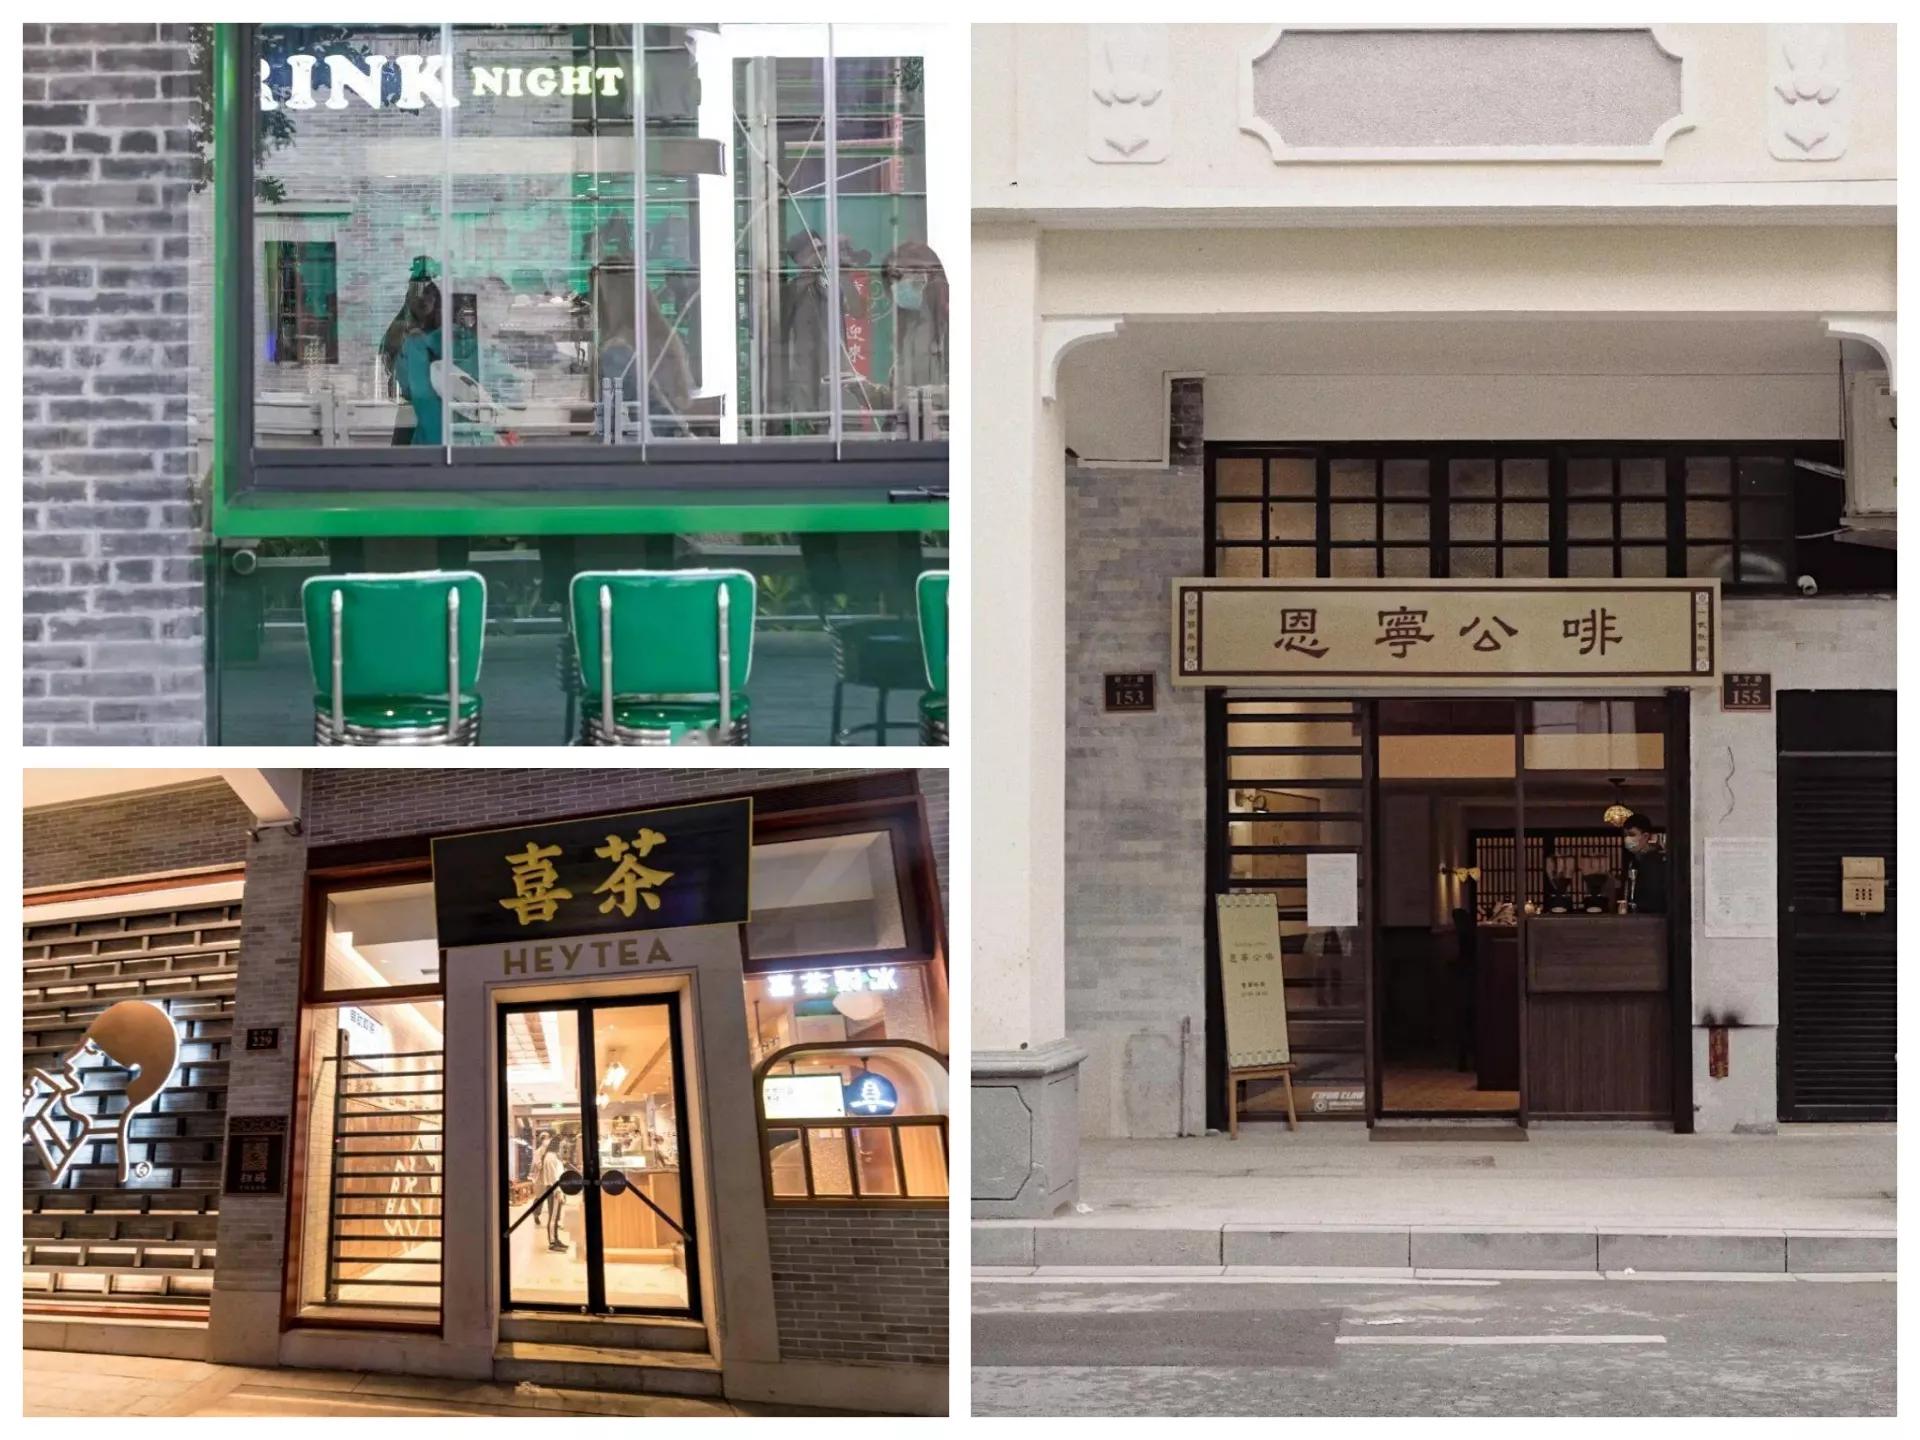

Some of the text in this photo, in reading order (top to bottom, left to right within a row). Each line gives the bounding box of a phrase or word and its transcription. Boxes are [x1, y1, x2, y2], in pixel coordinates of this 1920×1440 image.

[472, 66, 624, 97] NIGHT
[1274, 605, 1624, 660] 恩寧公啡
[1115, 690, 1145, 705] 153
[1732, 690, 1761, 705] 155
[499, 828, 675, 926] 喜茶
[503, 936, 672, 976] HEYTEA
